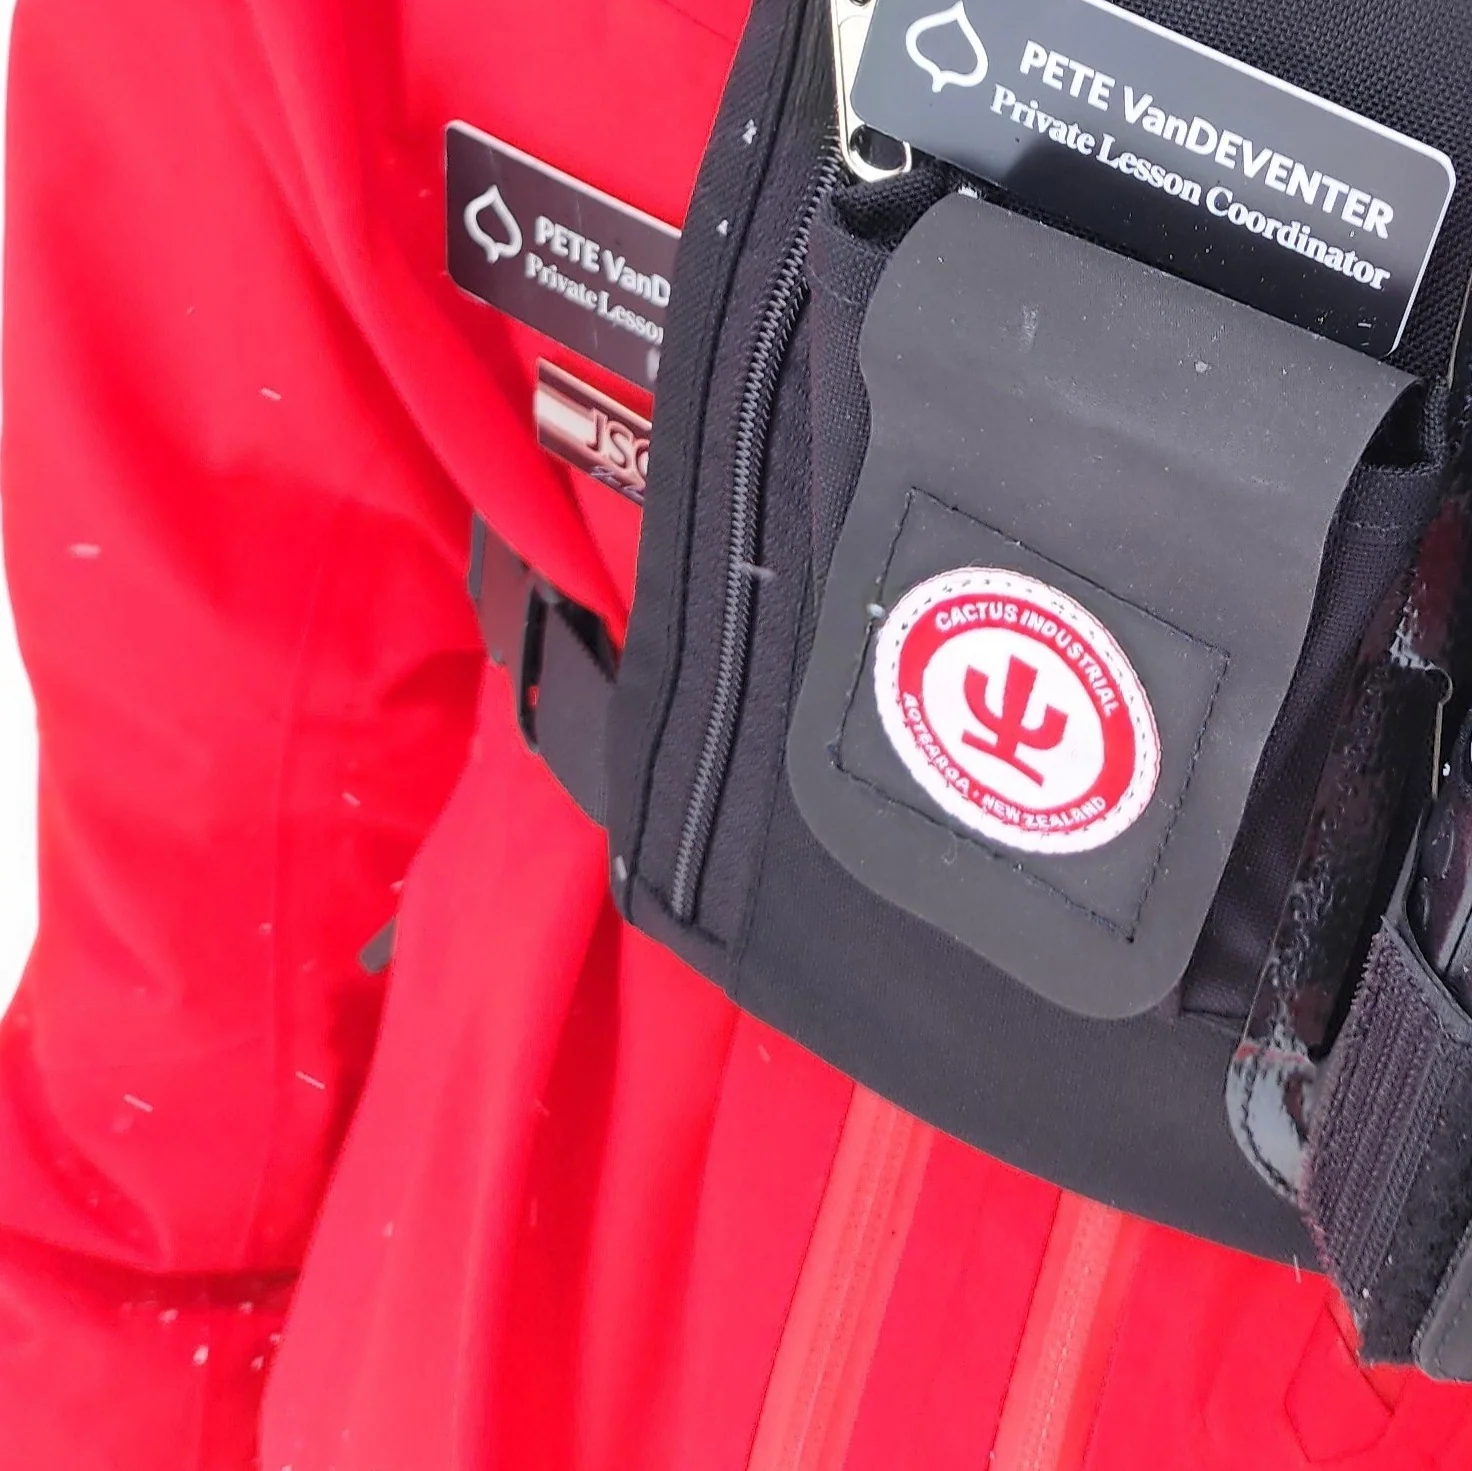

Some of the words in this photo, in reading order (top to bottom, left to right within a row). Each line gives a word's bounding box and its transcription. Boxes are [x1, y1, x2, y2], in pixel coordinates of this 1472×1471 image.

[990, 84, 1097, 158] Private
[1096, 133, 1202, 206] Lesson
[1205, 178, 1391, 292] Coordinator
[1019, 39, 1116, 110] PETE
[1123, 85, 1395, 240] VanDEVENTER
[524, 249, 600, 308] Private
[534, 215, 602, 274] PETE
[935, 599, 1019, 633] CACTUS
[1019, 608, 1121, 718] INDUSTRIAL
[901, 690, 971, 796] AOTEAROA
[980, 793, 1022, 825] NEW
[1020, 793, 1108, 830] ZEALAND
